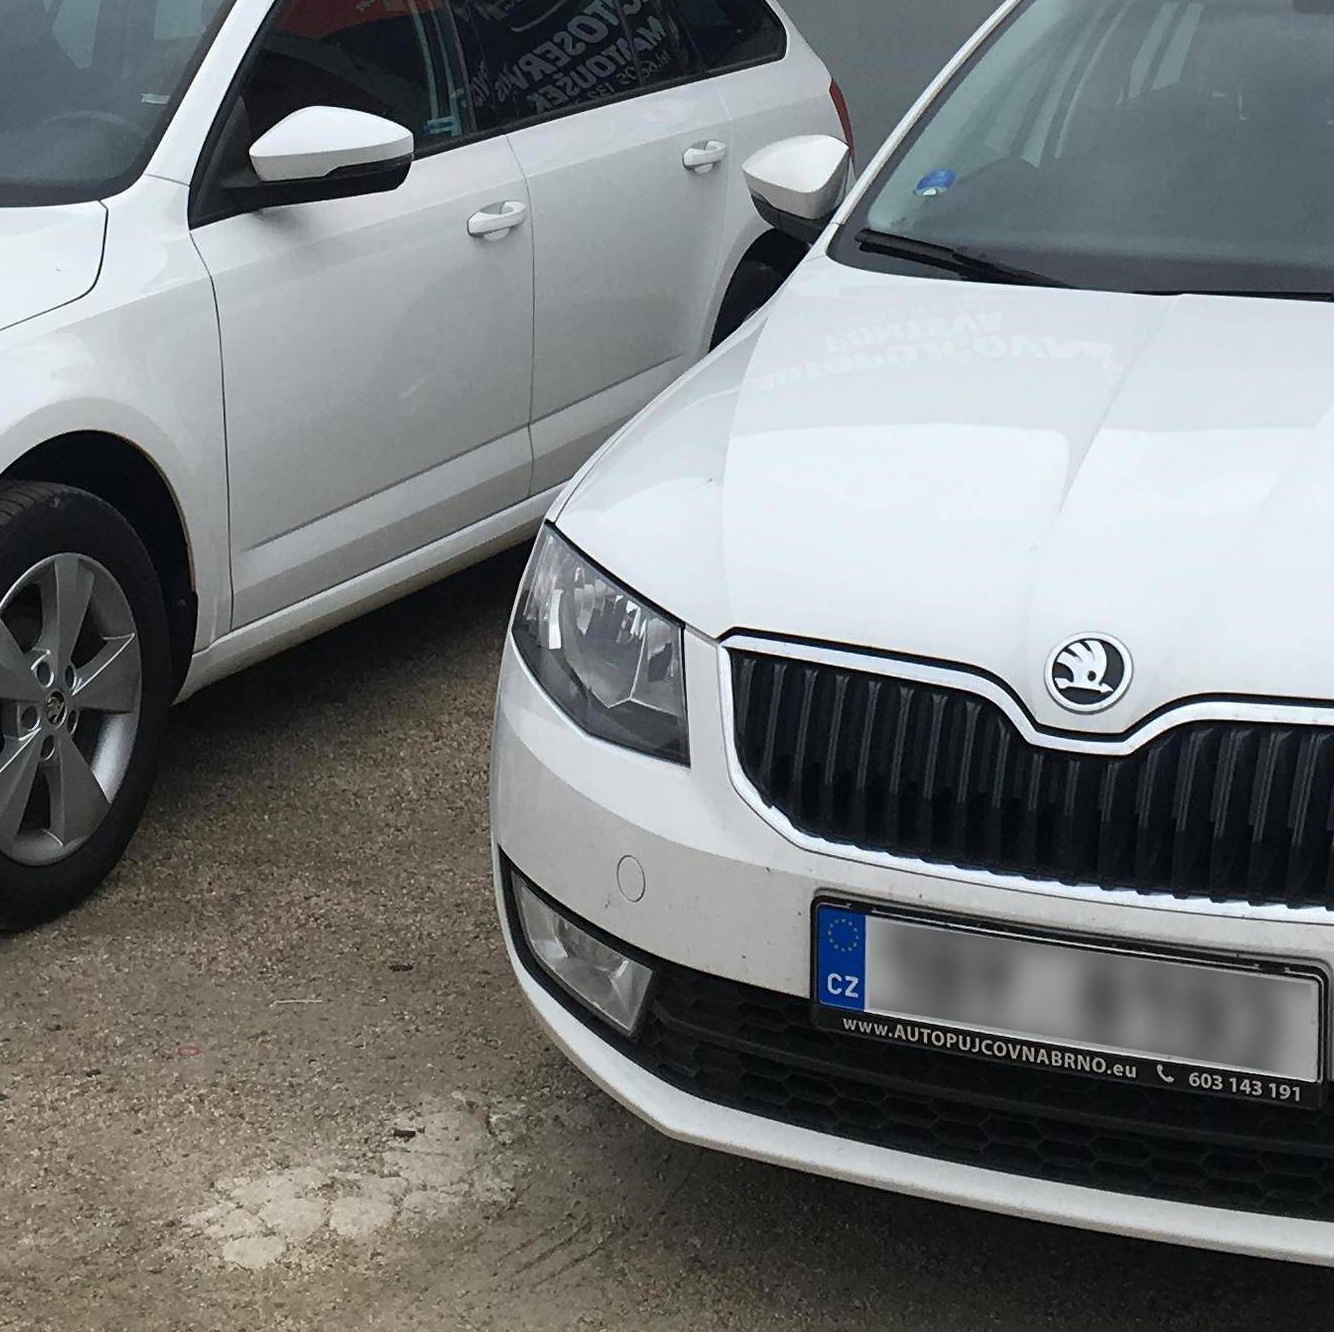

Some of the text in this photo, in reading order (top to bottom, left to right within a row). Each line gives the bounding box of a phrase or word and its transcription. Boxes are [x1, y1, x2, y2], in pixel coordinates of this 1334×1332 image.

[826, 972, 860, 999] CZ
[842, 1015, 1302, 1102] www.AUTOPUJCOVNABRNO.eu 603 143 191
